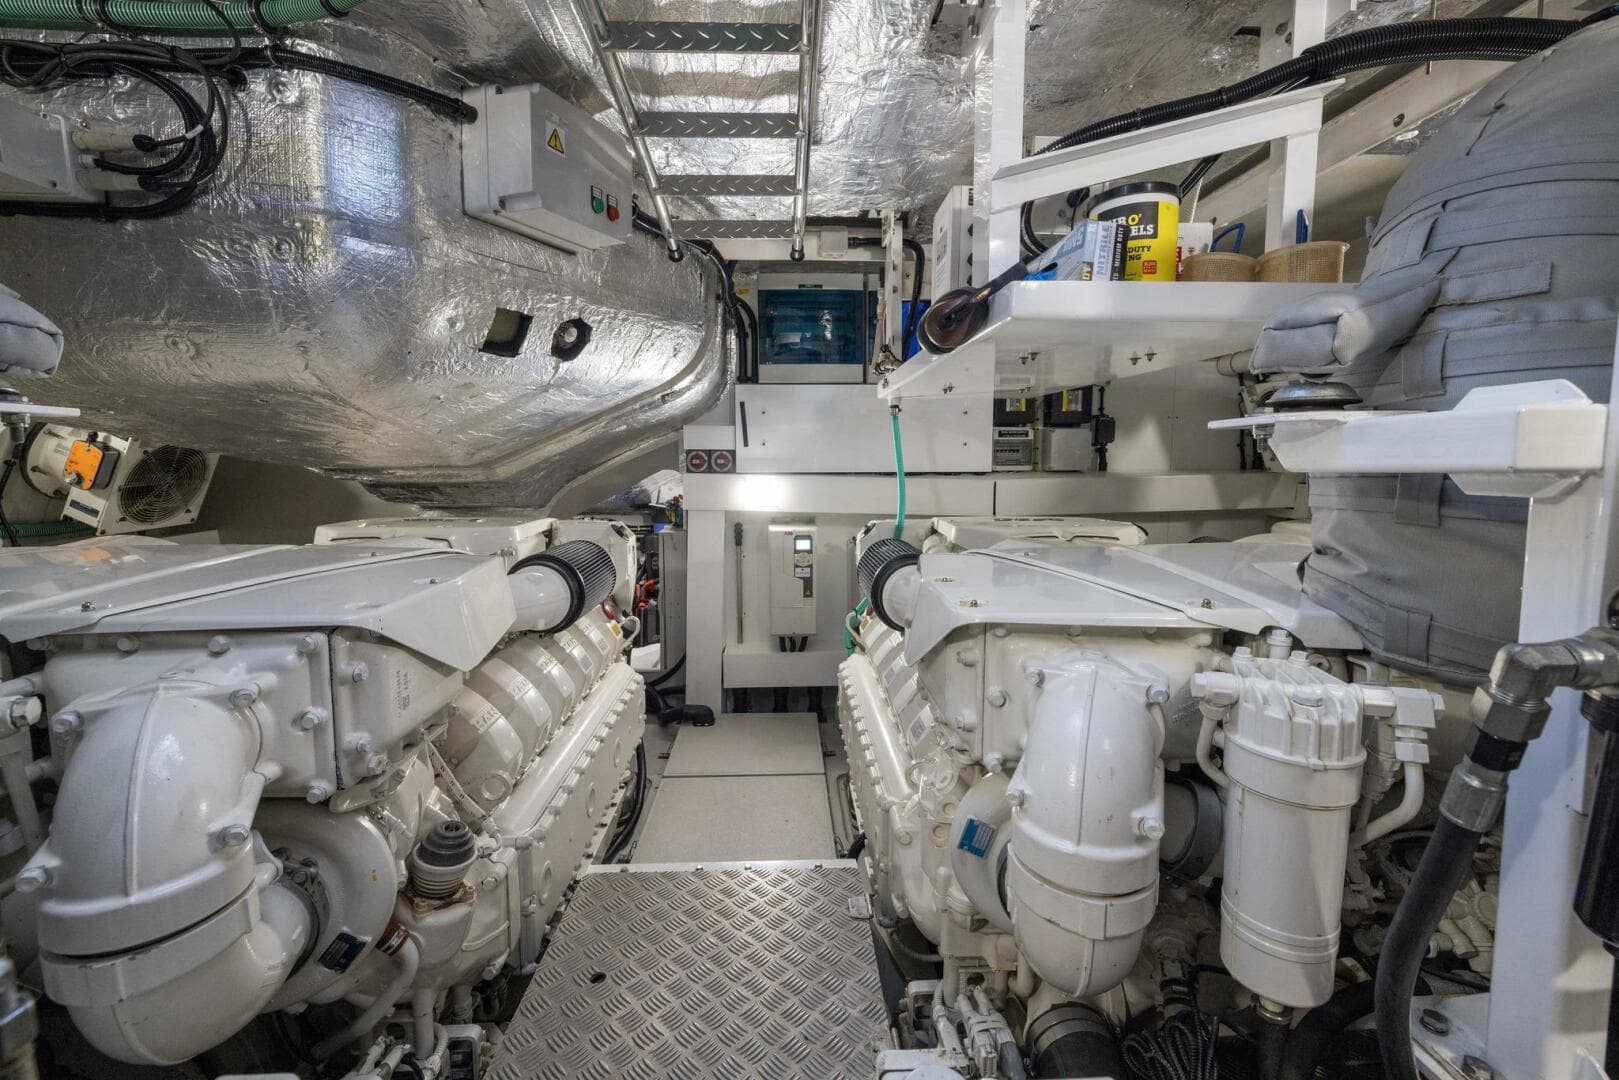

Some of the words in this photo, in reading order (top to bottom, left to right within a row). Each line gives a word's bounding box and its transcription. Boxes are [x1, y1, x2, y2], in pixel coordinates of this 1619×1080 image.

[1117, 226, 1125, 242] DUTY
[1130, 224, 1154, 236] ELS
[1096, 223, 1109, 275] NITRILE
[1114, 242, 1122, 267] MEDIUM
[1127, 245, 1151, 253] DUTY
[1128, 253, 1141, 261] NG
